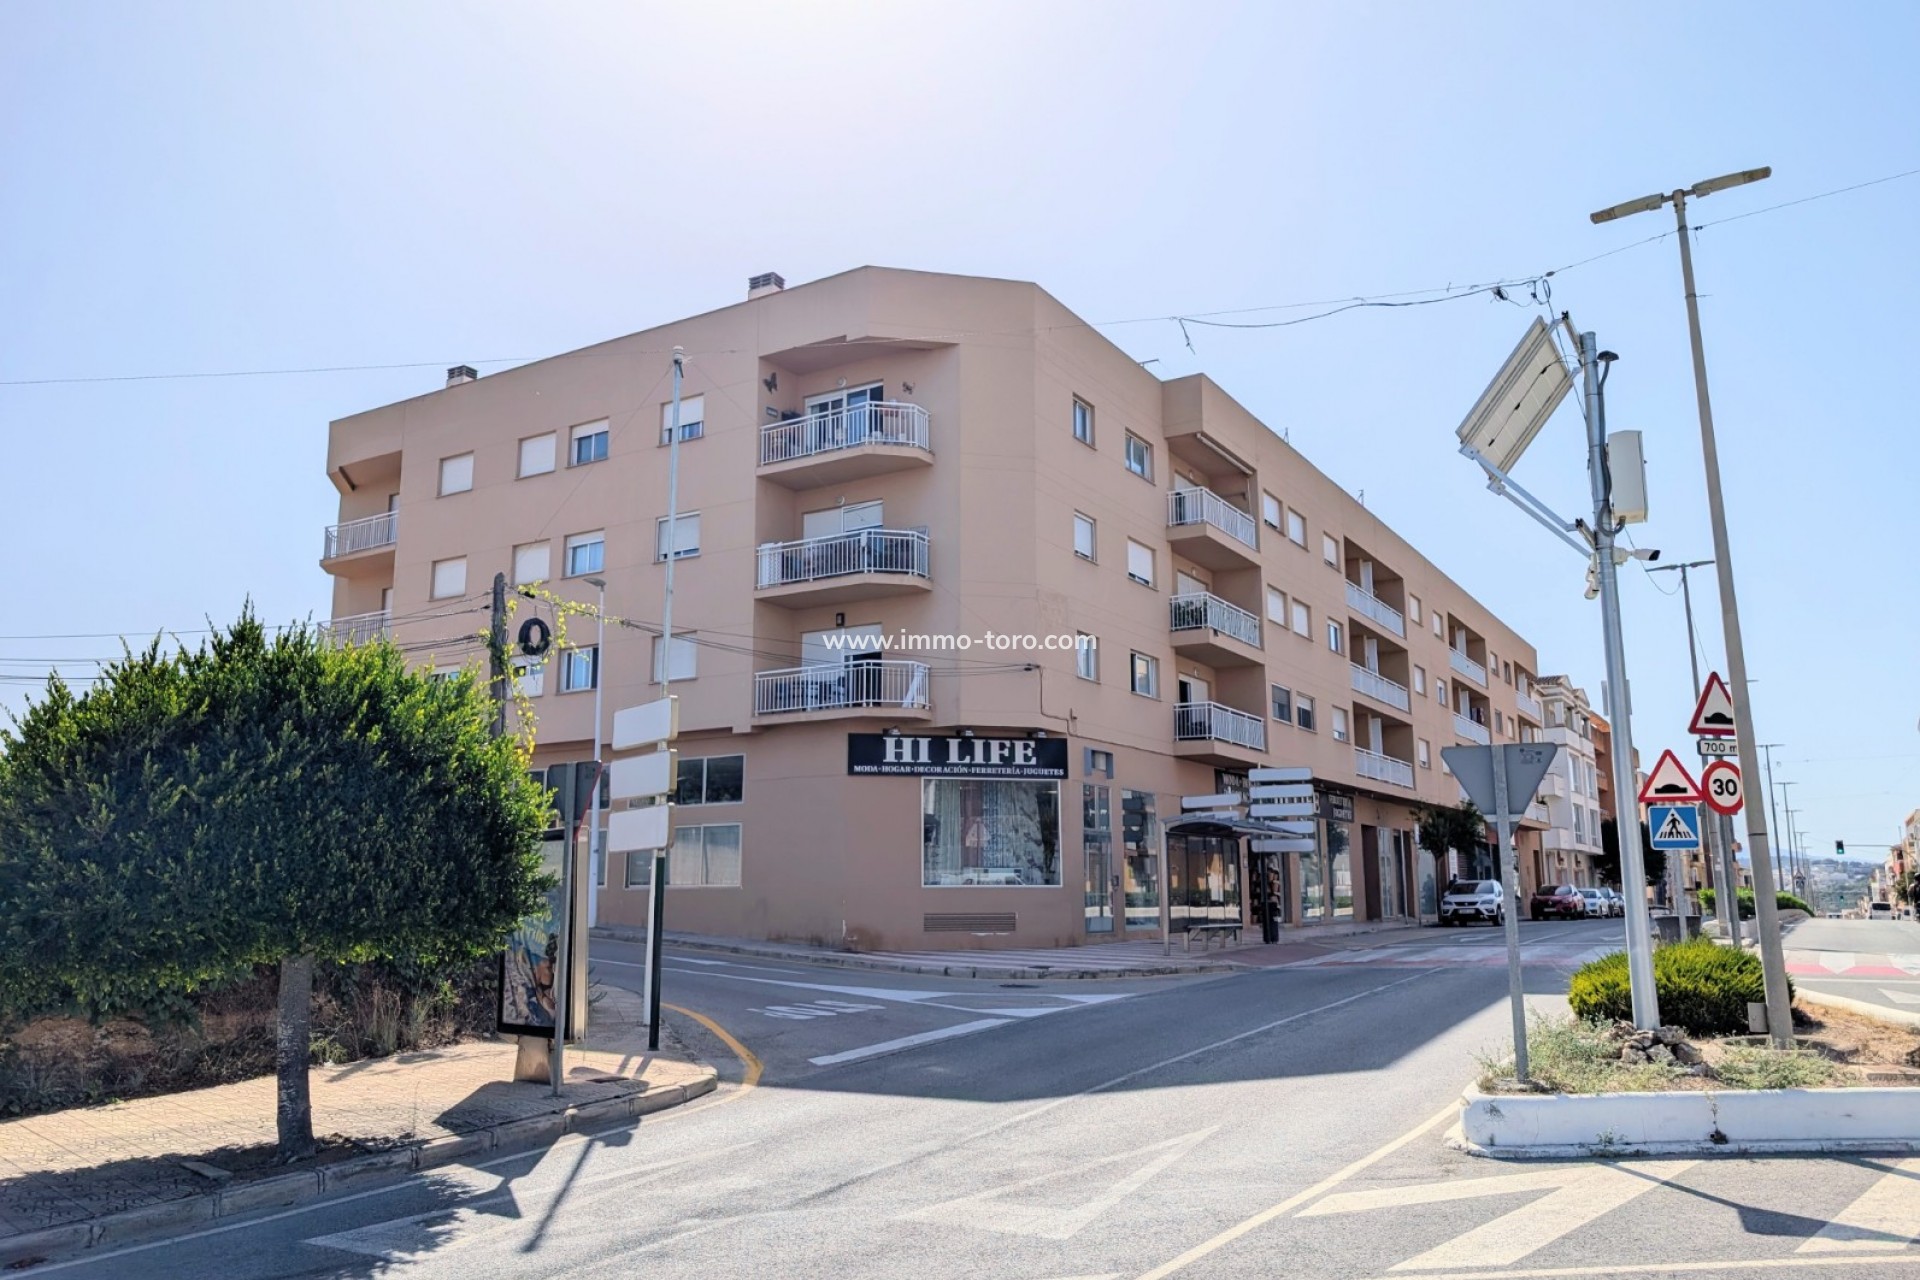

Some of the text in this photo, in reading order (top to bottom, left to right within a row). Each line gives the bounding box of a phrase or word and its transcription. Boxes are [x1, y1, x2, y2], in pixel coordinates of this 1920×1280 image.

[883, 737, 1037, 765] HI LIFE
[1704, 742, 1726, 752] 700
[1713, 778, 1738, 796] 30
